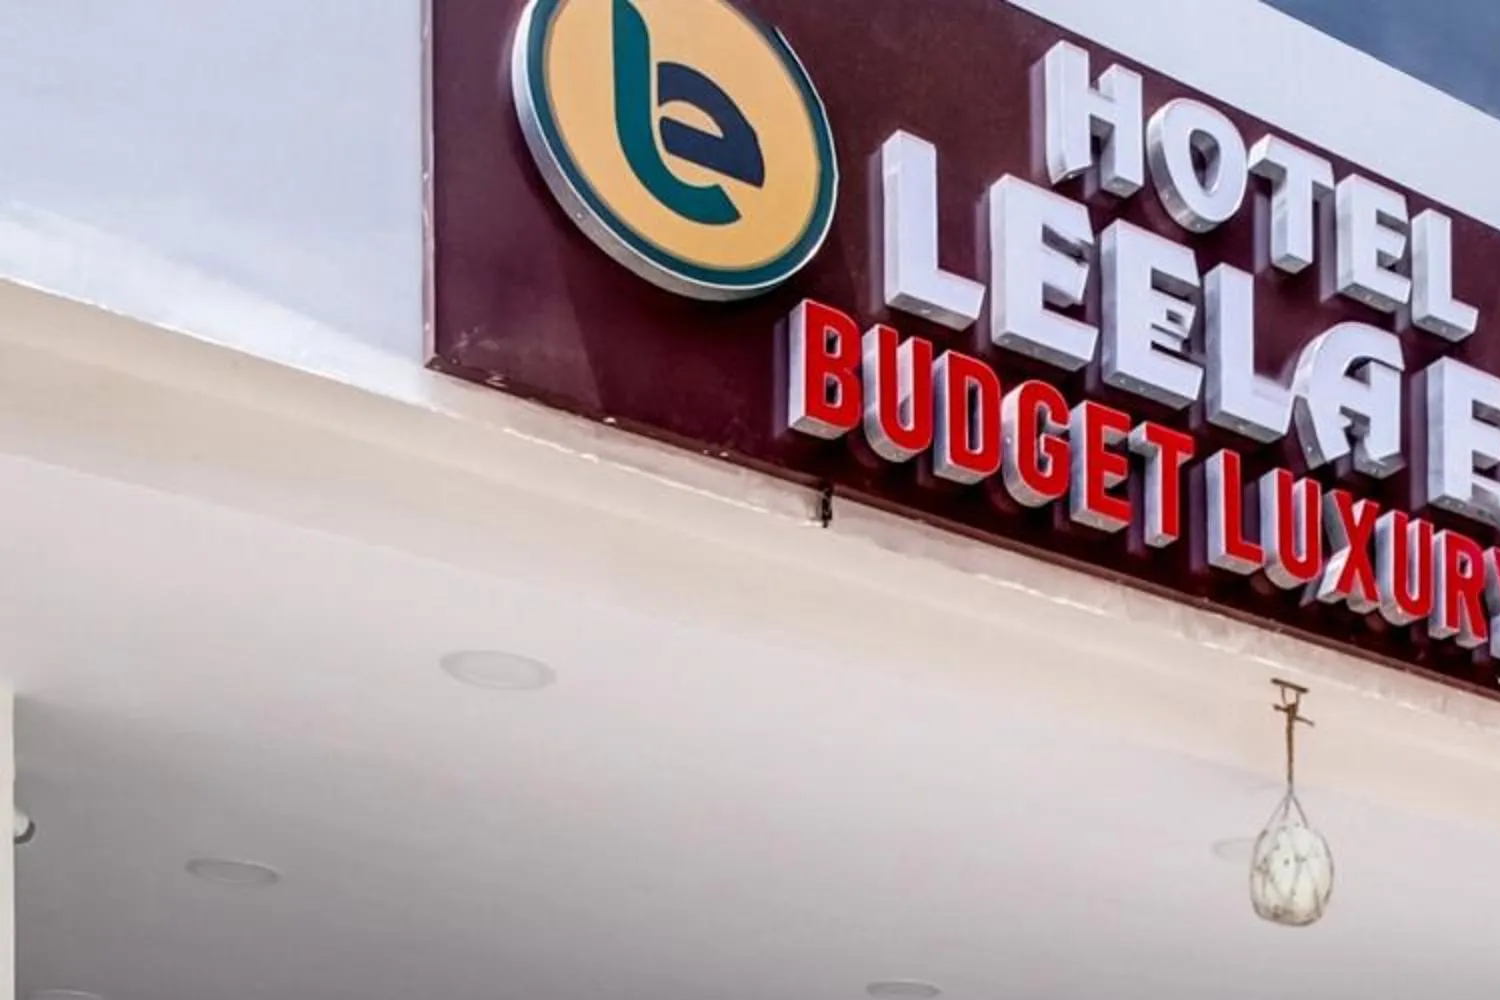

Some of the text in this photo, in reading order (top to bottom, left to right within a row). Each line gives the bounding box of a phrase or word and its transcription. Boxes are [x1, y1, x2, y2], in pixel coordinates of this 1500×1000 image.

[880, 129, 1406, 479] LEELA
[1040, 39, 1479, 343] HOTEL
[788, 298, 1195, 548] BUDGET
